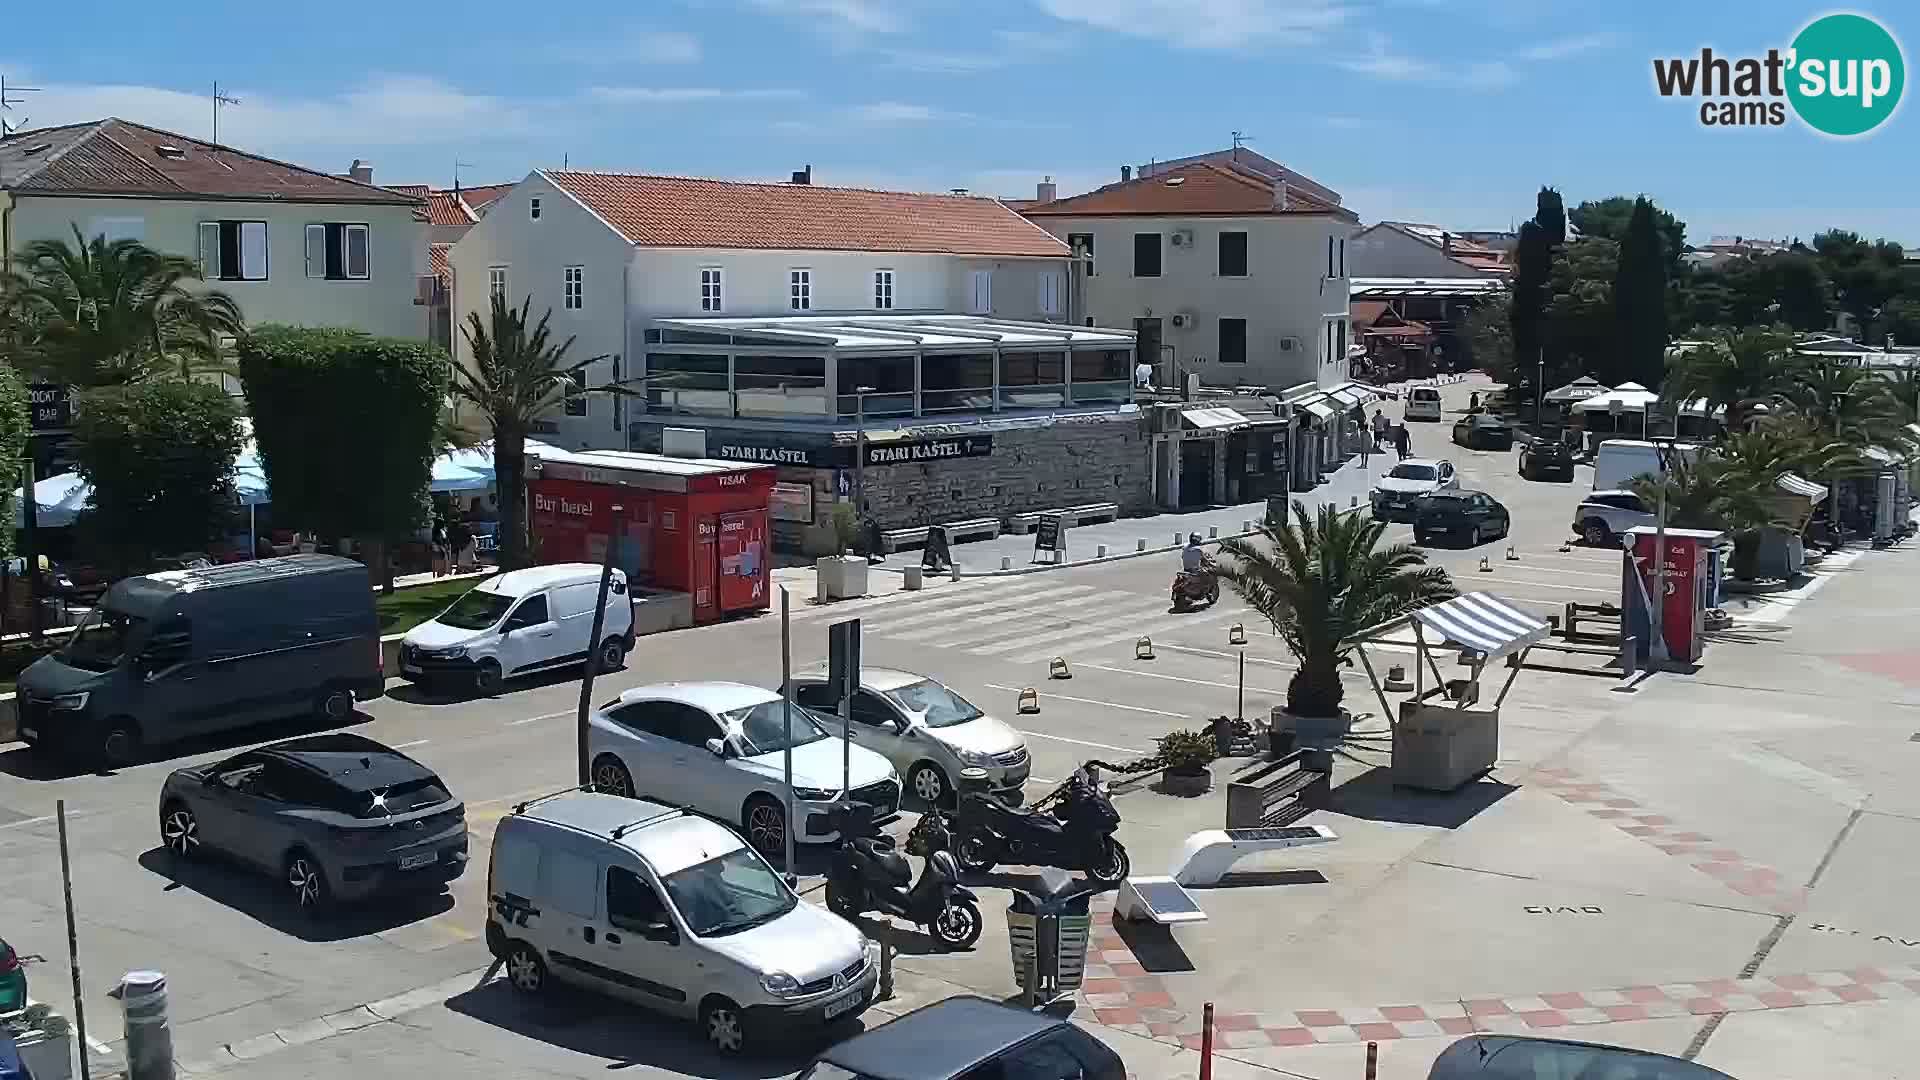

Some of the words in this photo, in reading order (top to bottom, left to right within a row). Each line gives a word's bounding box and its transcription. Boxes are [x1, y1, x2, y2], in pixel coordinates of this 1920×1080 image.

[721, 446, 757, 461] STARI
[759, 447, 809, 463] KAŠTEL
[871, 444, 909, 462] STARI
[912, 441, 962, 459] KAŠTEL
[535, 494, 556, 513] Buy
[561, 496, 593, 516] here!
[699, 522, 716, 536] Buy
[721, 520, 745, 533] here!
